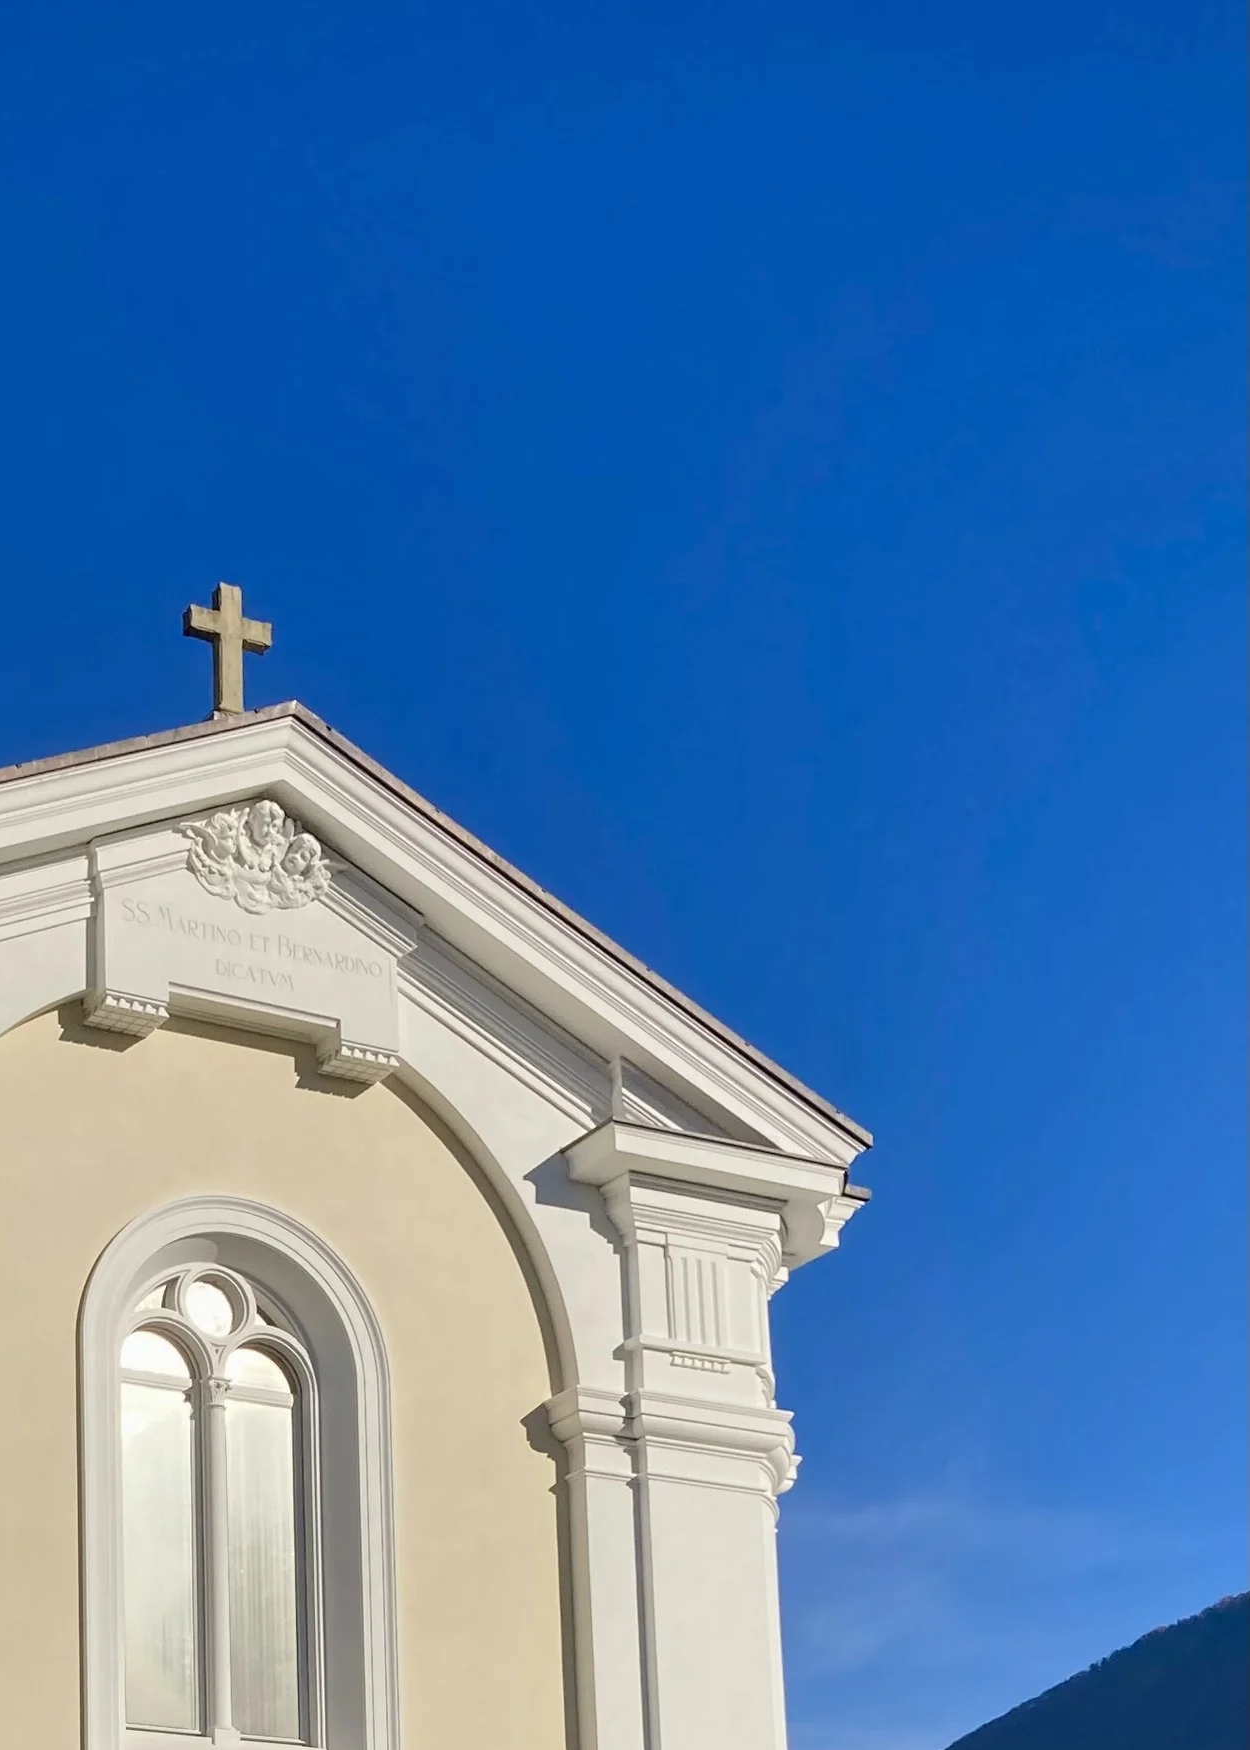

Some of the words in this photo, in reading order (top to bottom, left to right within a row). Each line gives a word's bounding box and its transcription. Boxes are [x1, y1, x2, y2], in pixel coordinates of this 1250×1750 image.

[156, 904, 242, 947] MARTINO
[249, 933, 270, 954] ET
[277, 934, 383, 978] BERNARDINO
